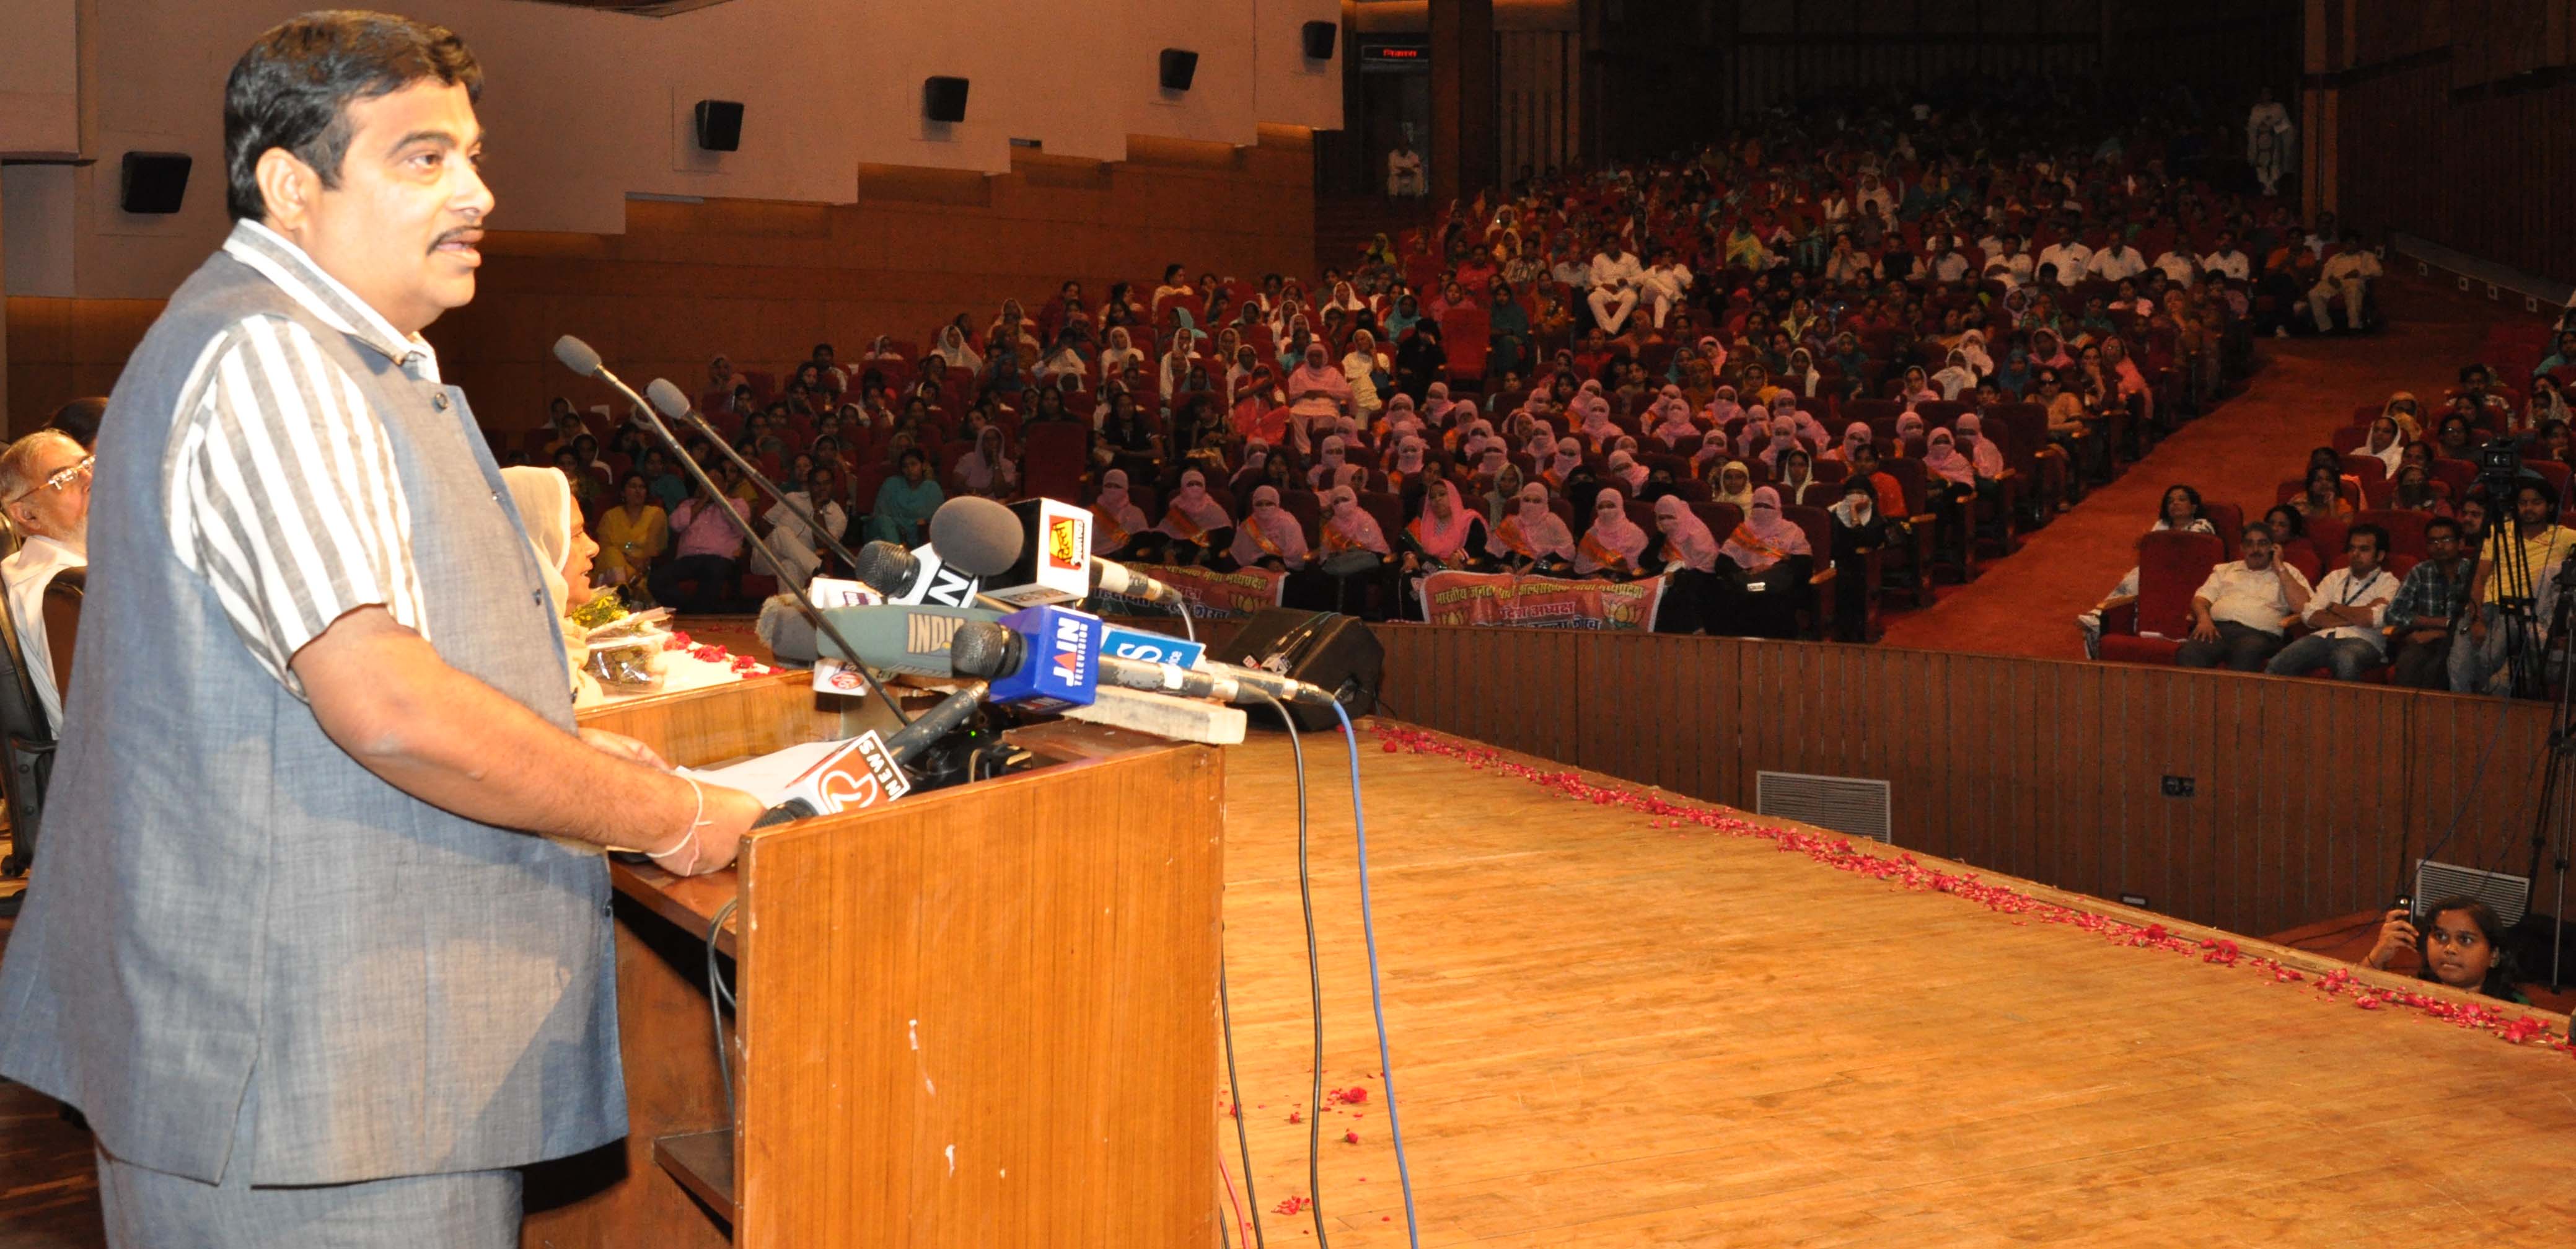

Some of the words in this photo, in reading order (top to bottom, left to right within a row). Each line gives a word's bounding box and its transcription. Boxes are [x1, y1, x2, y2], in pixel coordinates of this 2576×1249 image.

[1434, 586, 1467, 605] भारतीय
[1531, 601, 1576, 617] अध्यक्ष
[1053, 617, 1079, 687] JAIN
[1075, 622, 1088, 687] TELEVISION
[858, 739, 902, 798] NEWS
